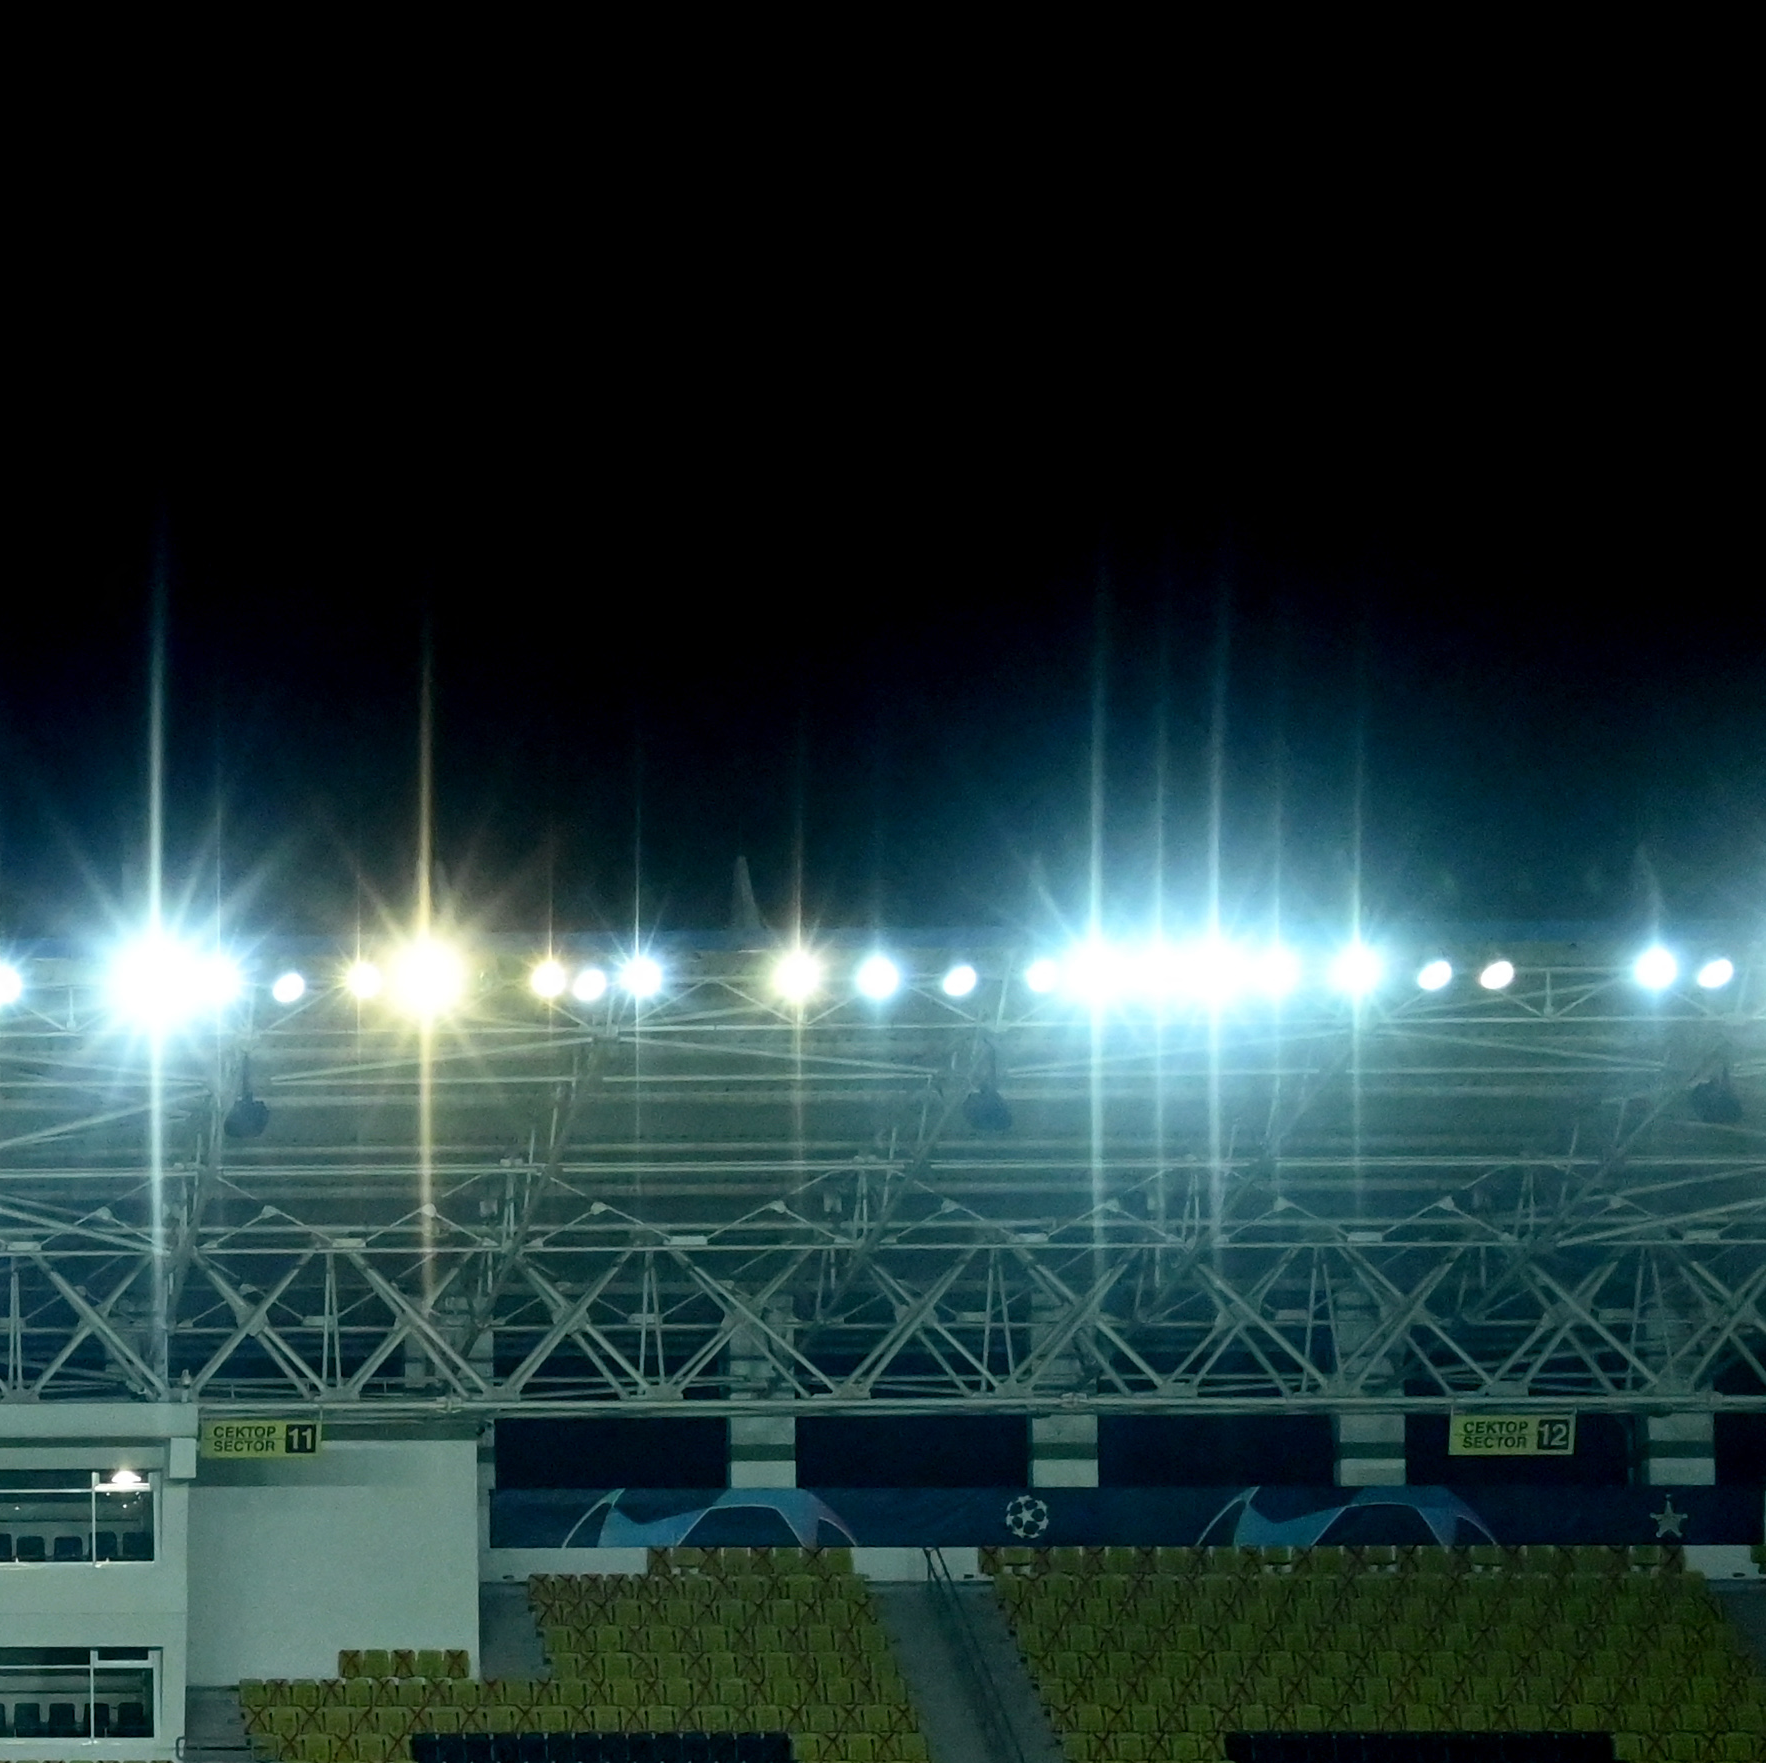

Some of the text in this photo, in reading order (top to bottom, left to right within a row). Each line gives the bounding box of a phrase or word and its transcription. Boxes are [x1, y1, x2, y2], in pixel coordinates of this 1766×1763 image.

[288, 1428, 312, 1450] 11
[1462, 1436, 1527, 1449] SECTOR
[1538, 1423, 1567, 1446] 12
[213, 1440, 275, 1452] SECTOR
